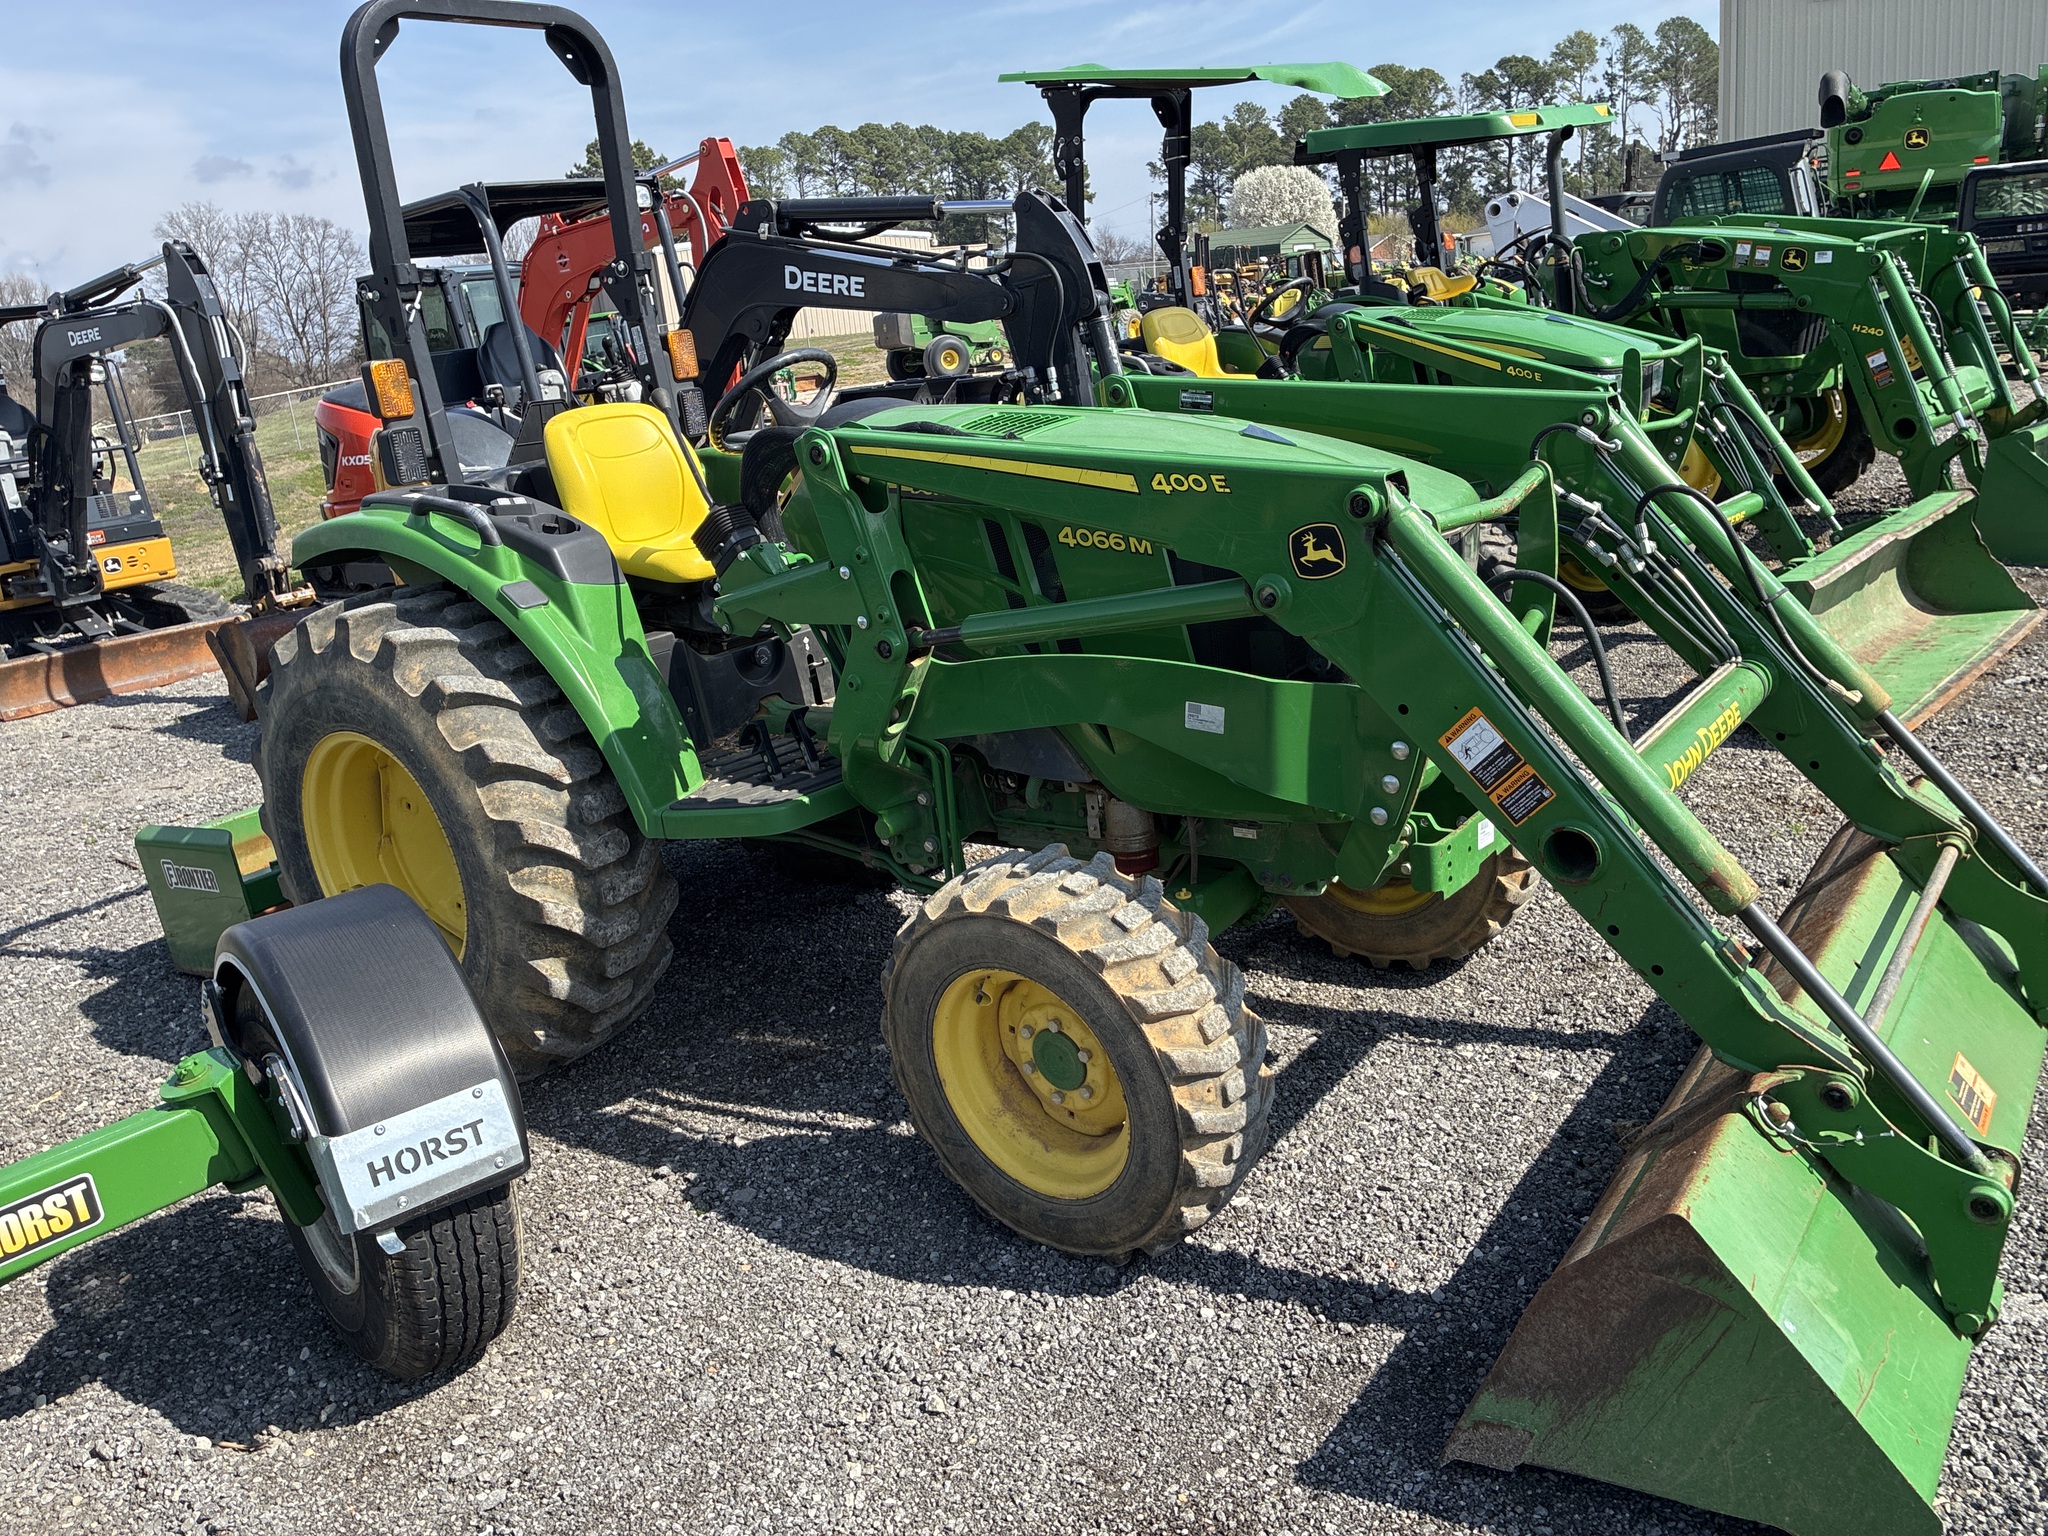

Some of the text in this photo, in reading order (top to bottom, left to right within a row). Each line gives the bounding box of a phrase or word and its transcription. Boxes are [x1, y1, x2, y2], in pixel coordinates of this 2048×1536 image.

[784, 264, 865, 298] DEERE
[67, 326, 102, 347] DEERE
[1506, 365, 1543, 382] 400 E
[1151, 473, 1231, 494] 400 E
[1058, 526, 1153, 555] 4066 M
[1449, 712, 1478, 739] WARNING
[1663, 700, 1742, 792] JOHN DEERE
[1501, 770, 1530, 794] WARNING
[161, 859, 220, 892] FRONTIER
[366, 1118, 484, 1188] HORST
[0, 1181, 91, 1258] ORST
